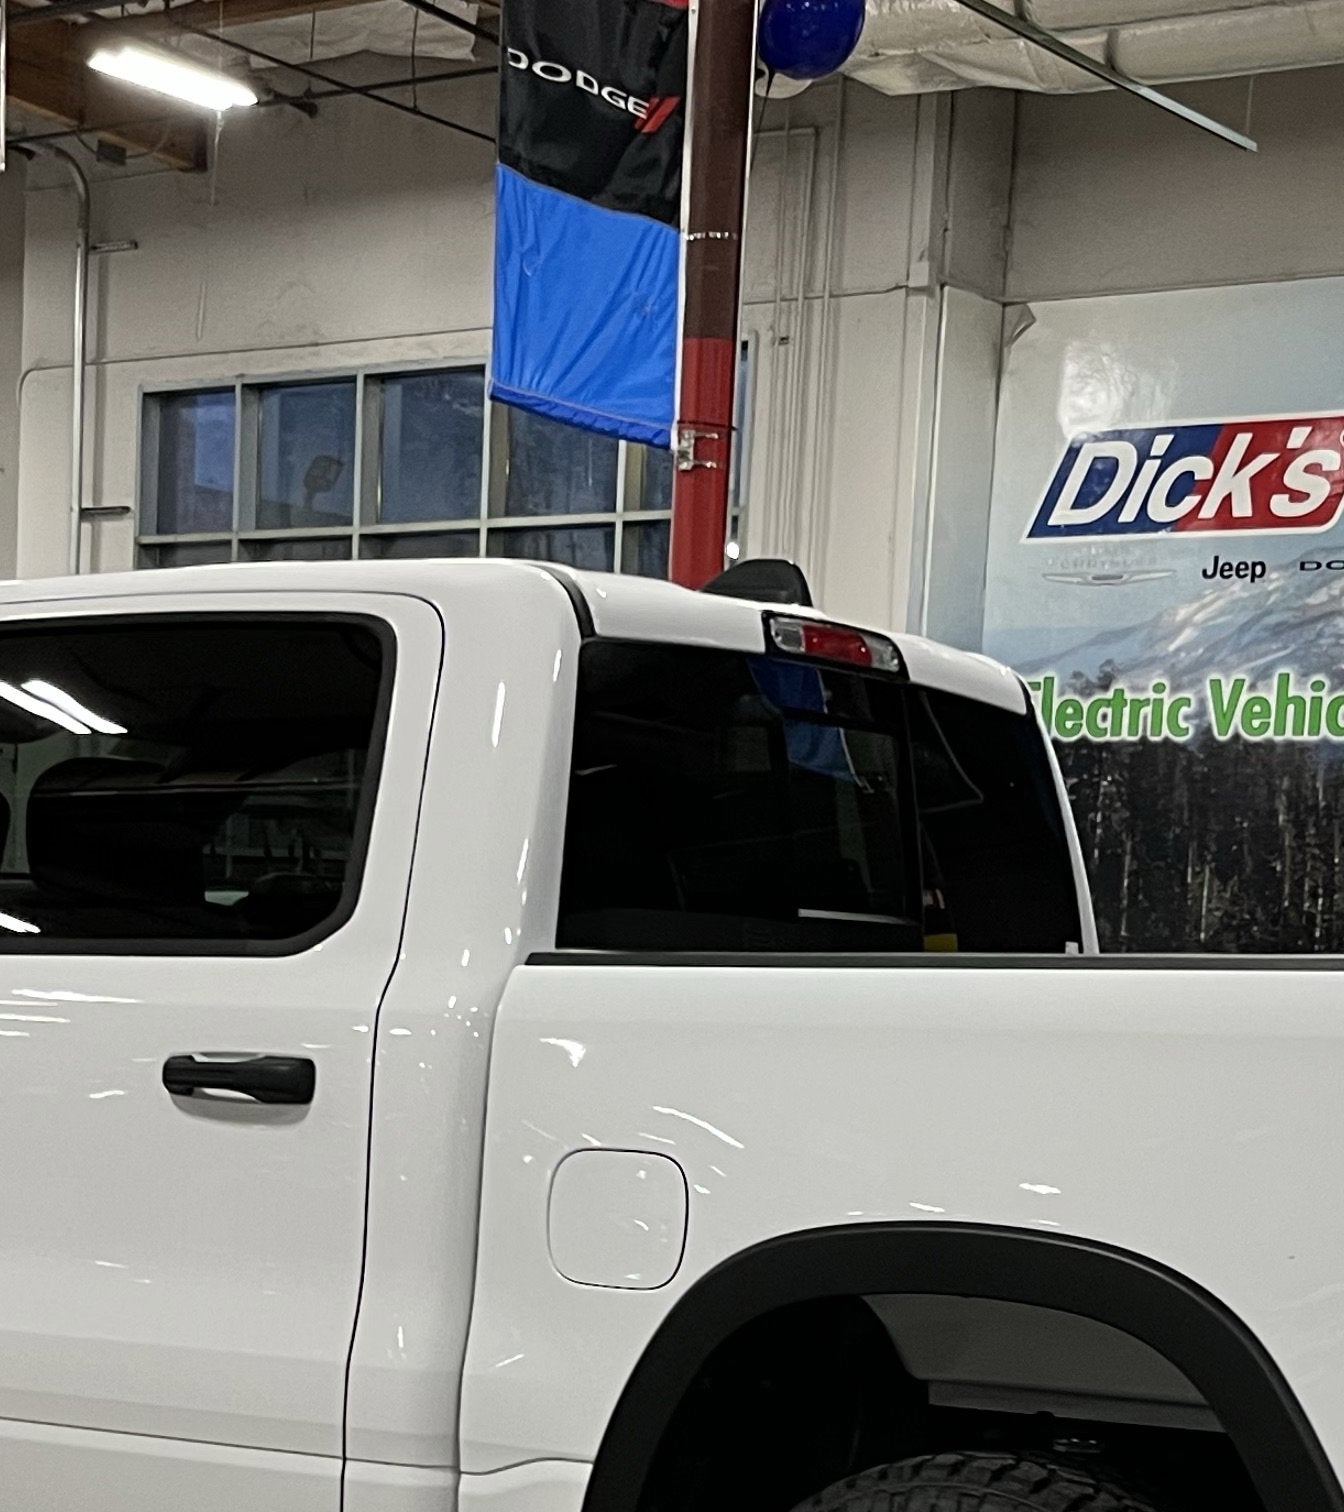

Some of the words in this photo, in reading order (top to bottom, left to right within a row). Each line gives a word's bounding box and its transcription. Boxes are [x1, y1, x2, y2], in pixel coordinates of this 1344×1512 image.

[507, 47, 651, 120] DODGE
[1047, 426, 1342, 526] Dick's
[1201, 555, 1267, 583] Jeep
[1027, 676, 1192, 738] lectric
